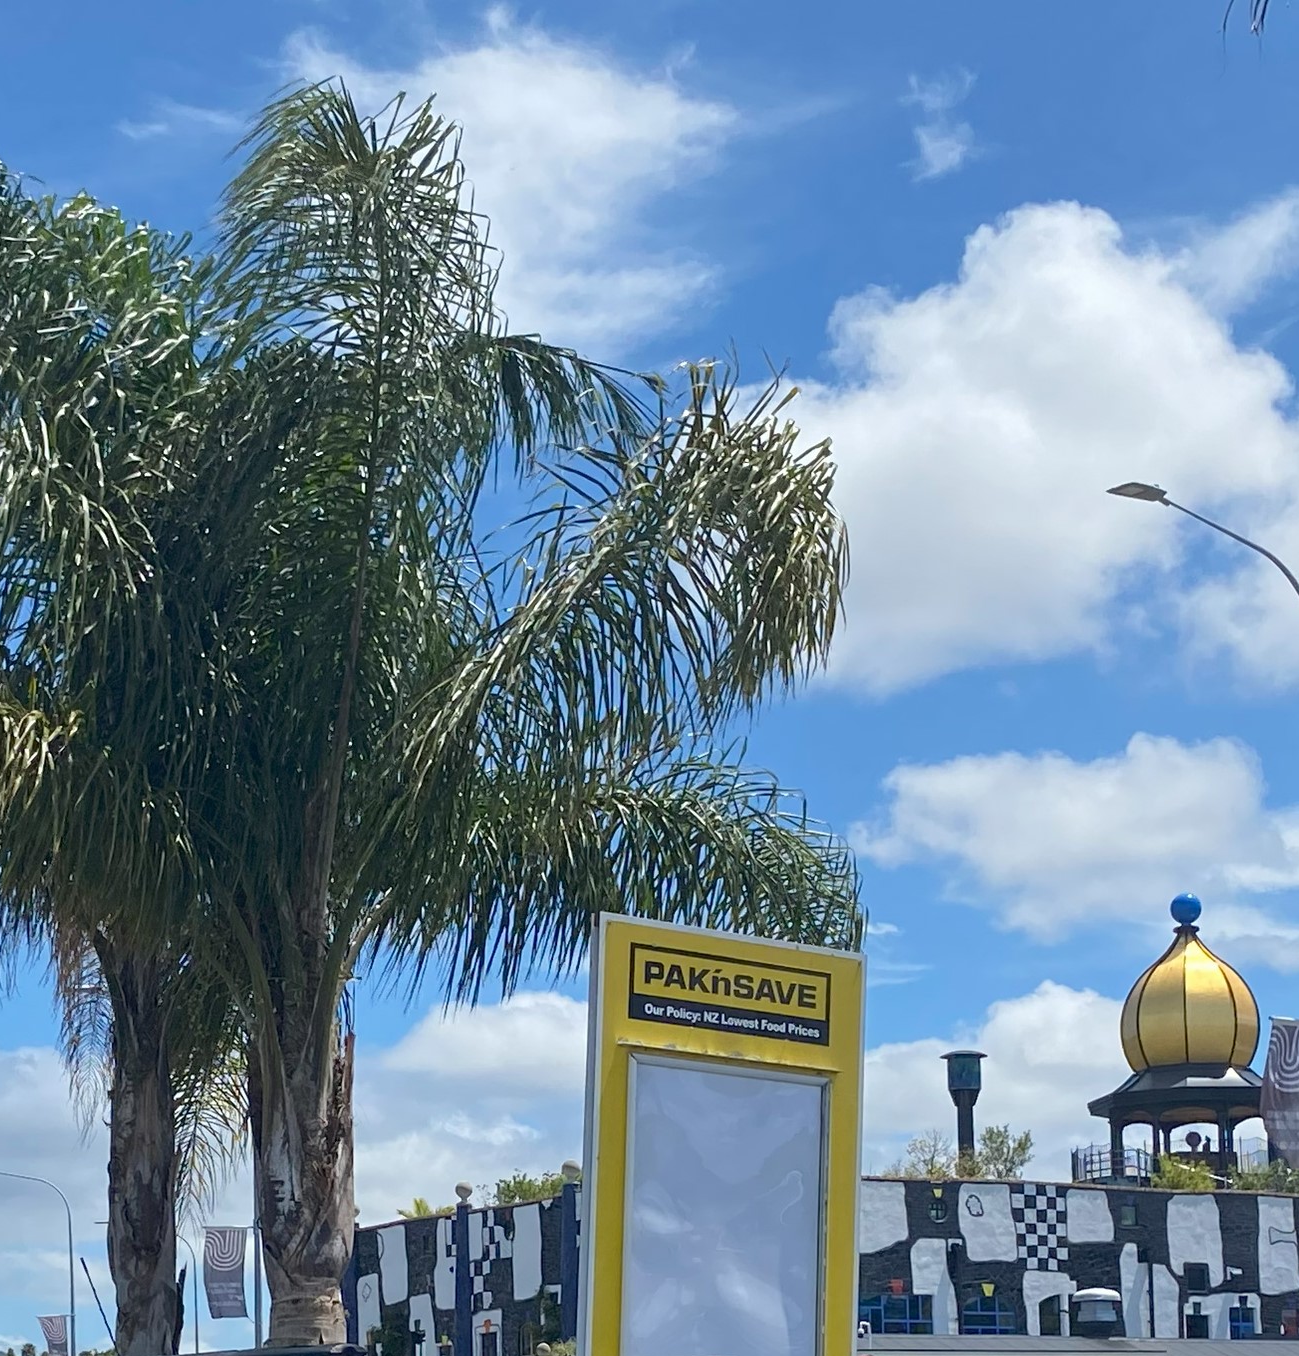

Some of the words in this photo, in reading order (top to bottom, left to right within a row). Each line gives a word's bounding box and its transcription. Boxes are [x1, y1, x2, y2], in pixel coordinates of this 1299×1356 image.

[644, 1003, 664, 1016] Our
[666, 1005, 701, 1022] Policy:
[703, 1010, 719, 1025] NZ
[721, 1013, 759, 1030] Lowest
[761, 1019, 786, 1034] Food
[788, 1022, 820, 1039] Prices
